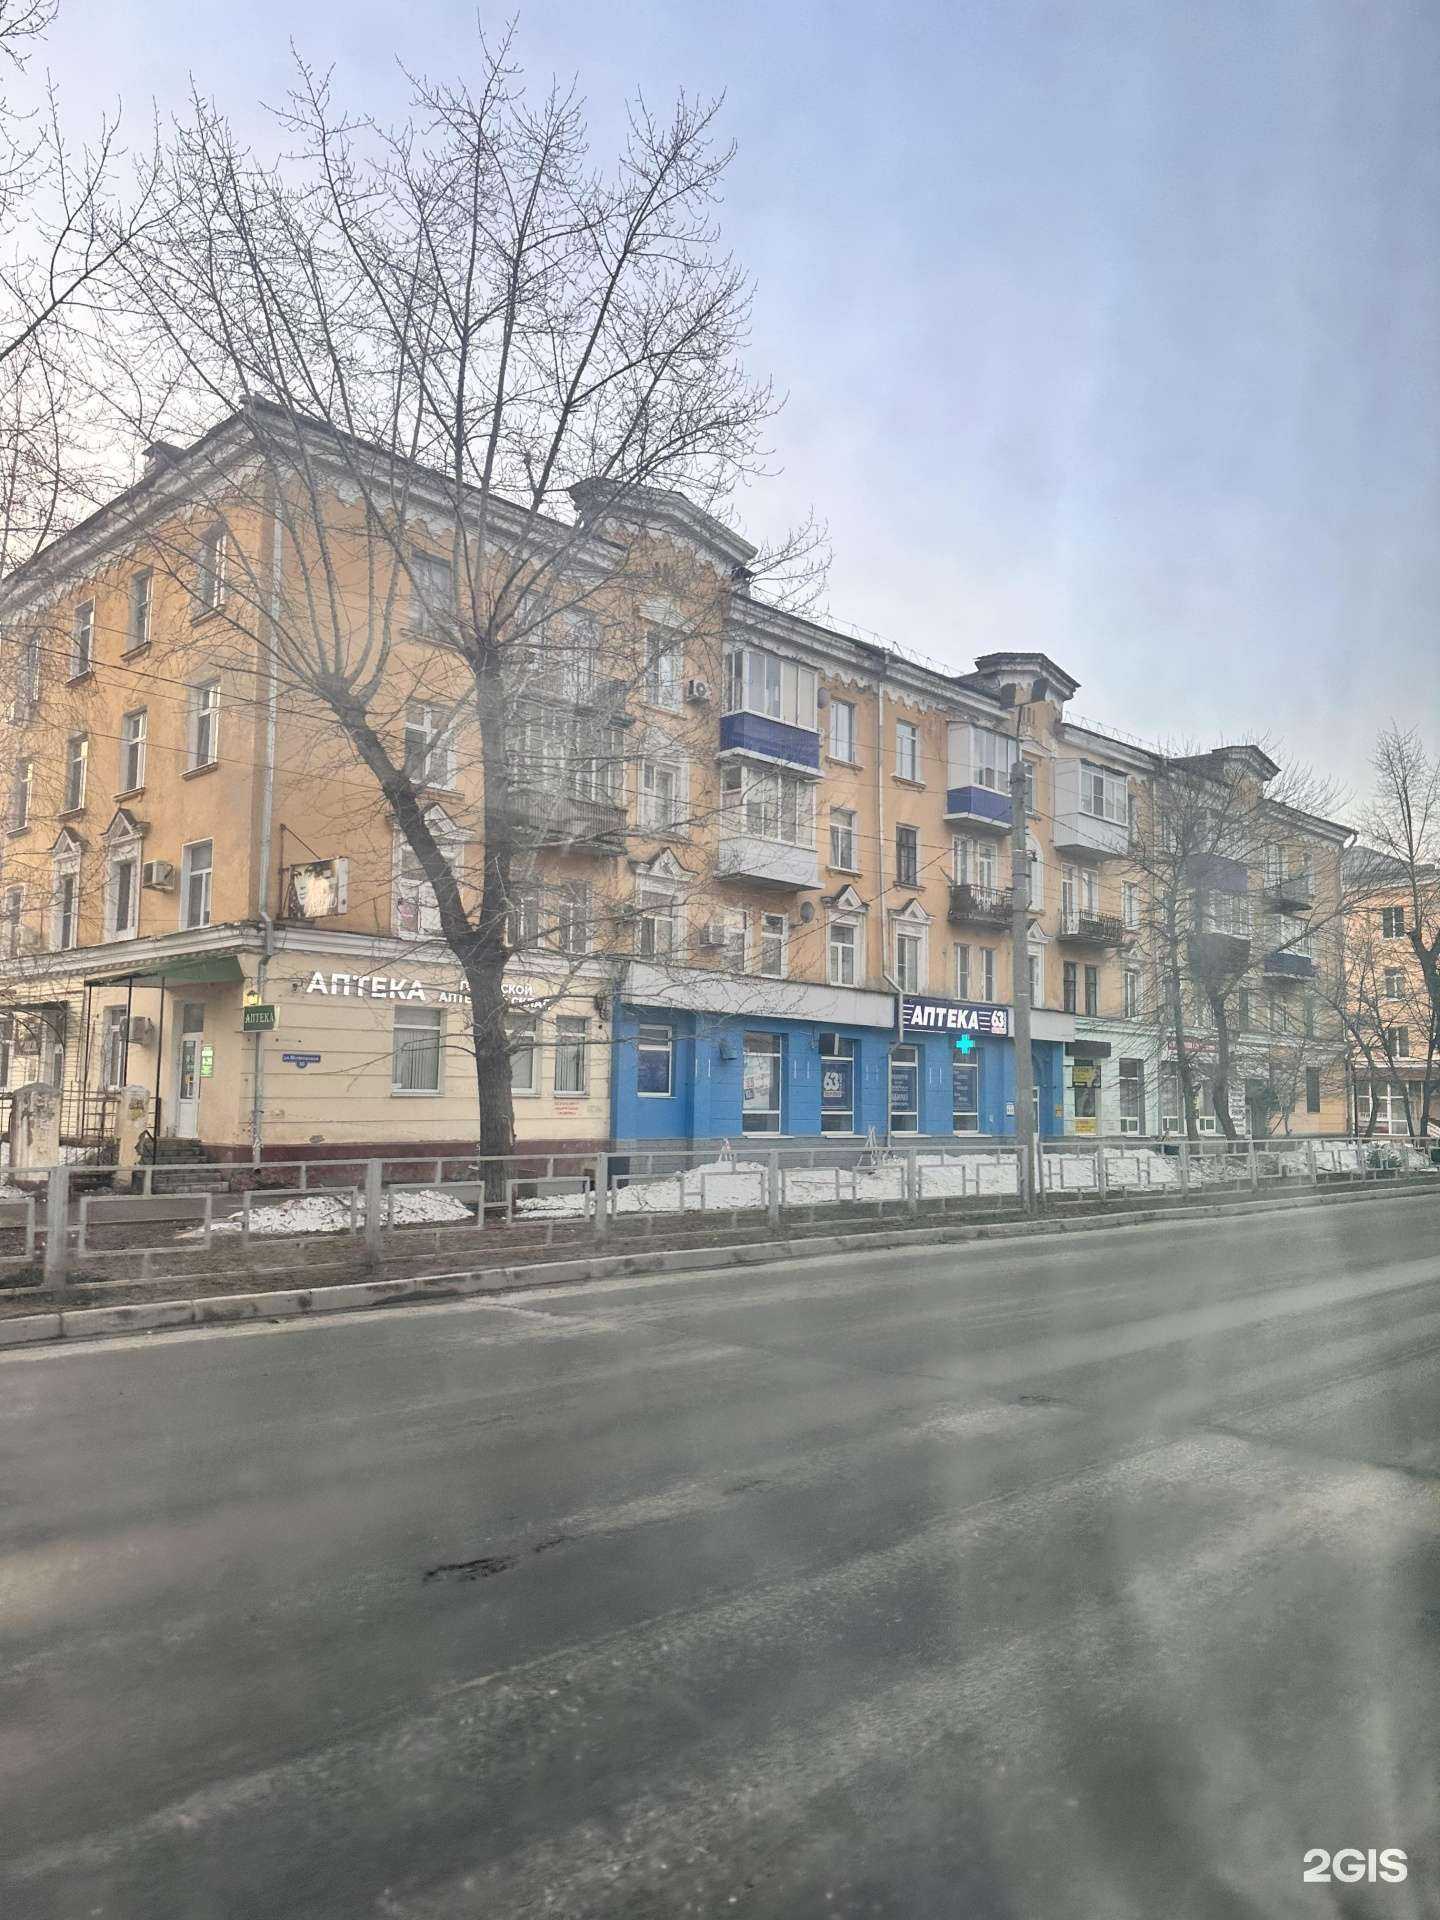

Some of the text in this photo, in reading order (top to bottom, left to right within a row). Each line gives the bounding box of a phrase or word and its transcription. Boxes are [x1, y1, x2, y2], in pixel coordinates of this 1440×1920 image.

[306, 971, 426, 1001] АПТЕКА
[245, 1012, 274, 1024] АПТЕКА
[911, 1005, 979, 1030] АПТЕКА
[991, 1010, 1004, 1028] 63
[823, 1071, 840, 1092] 63
